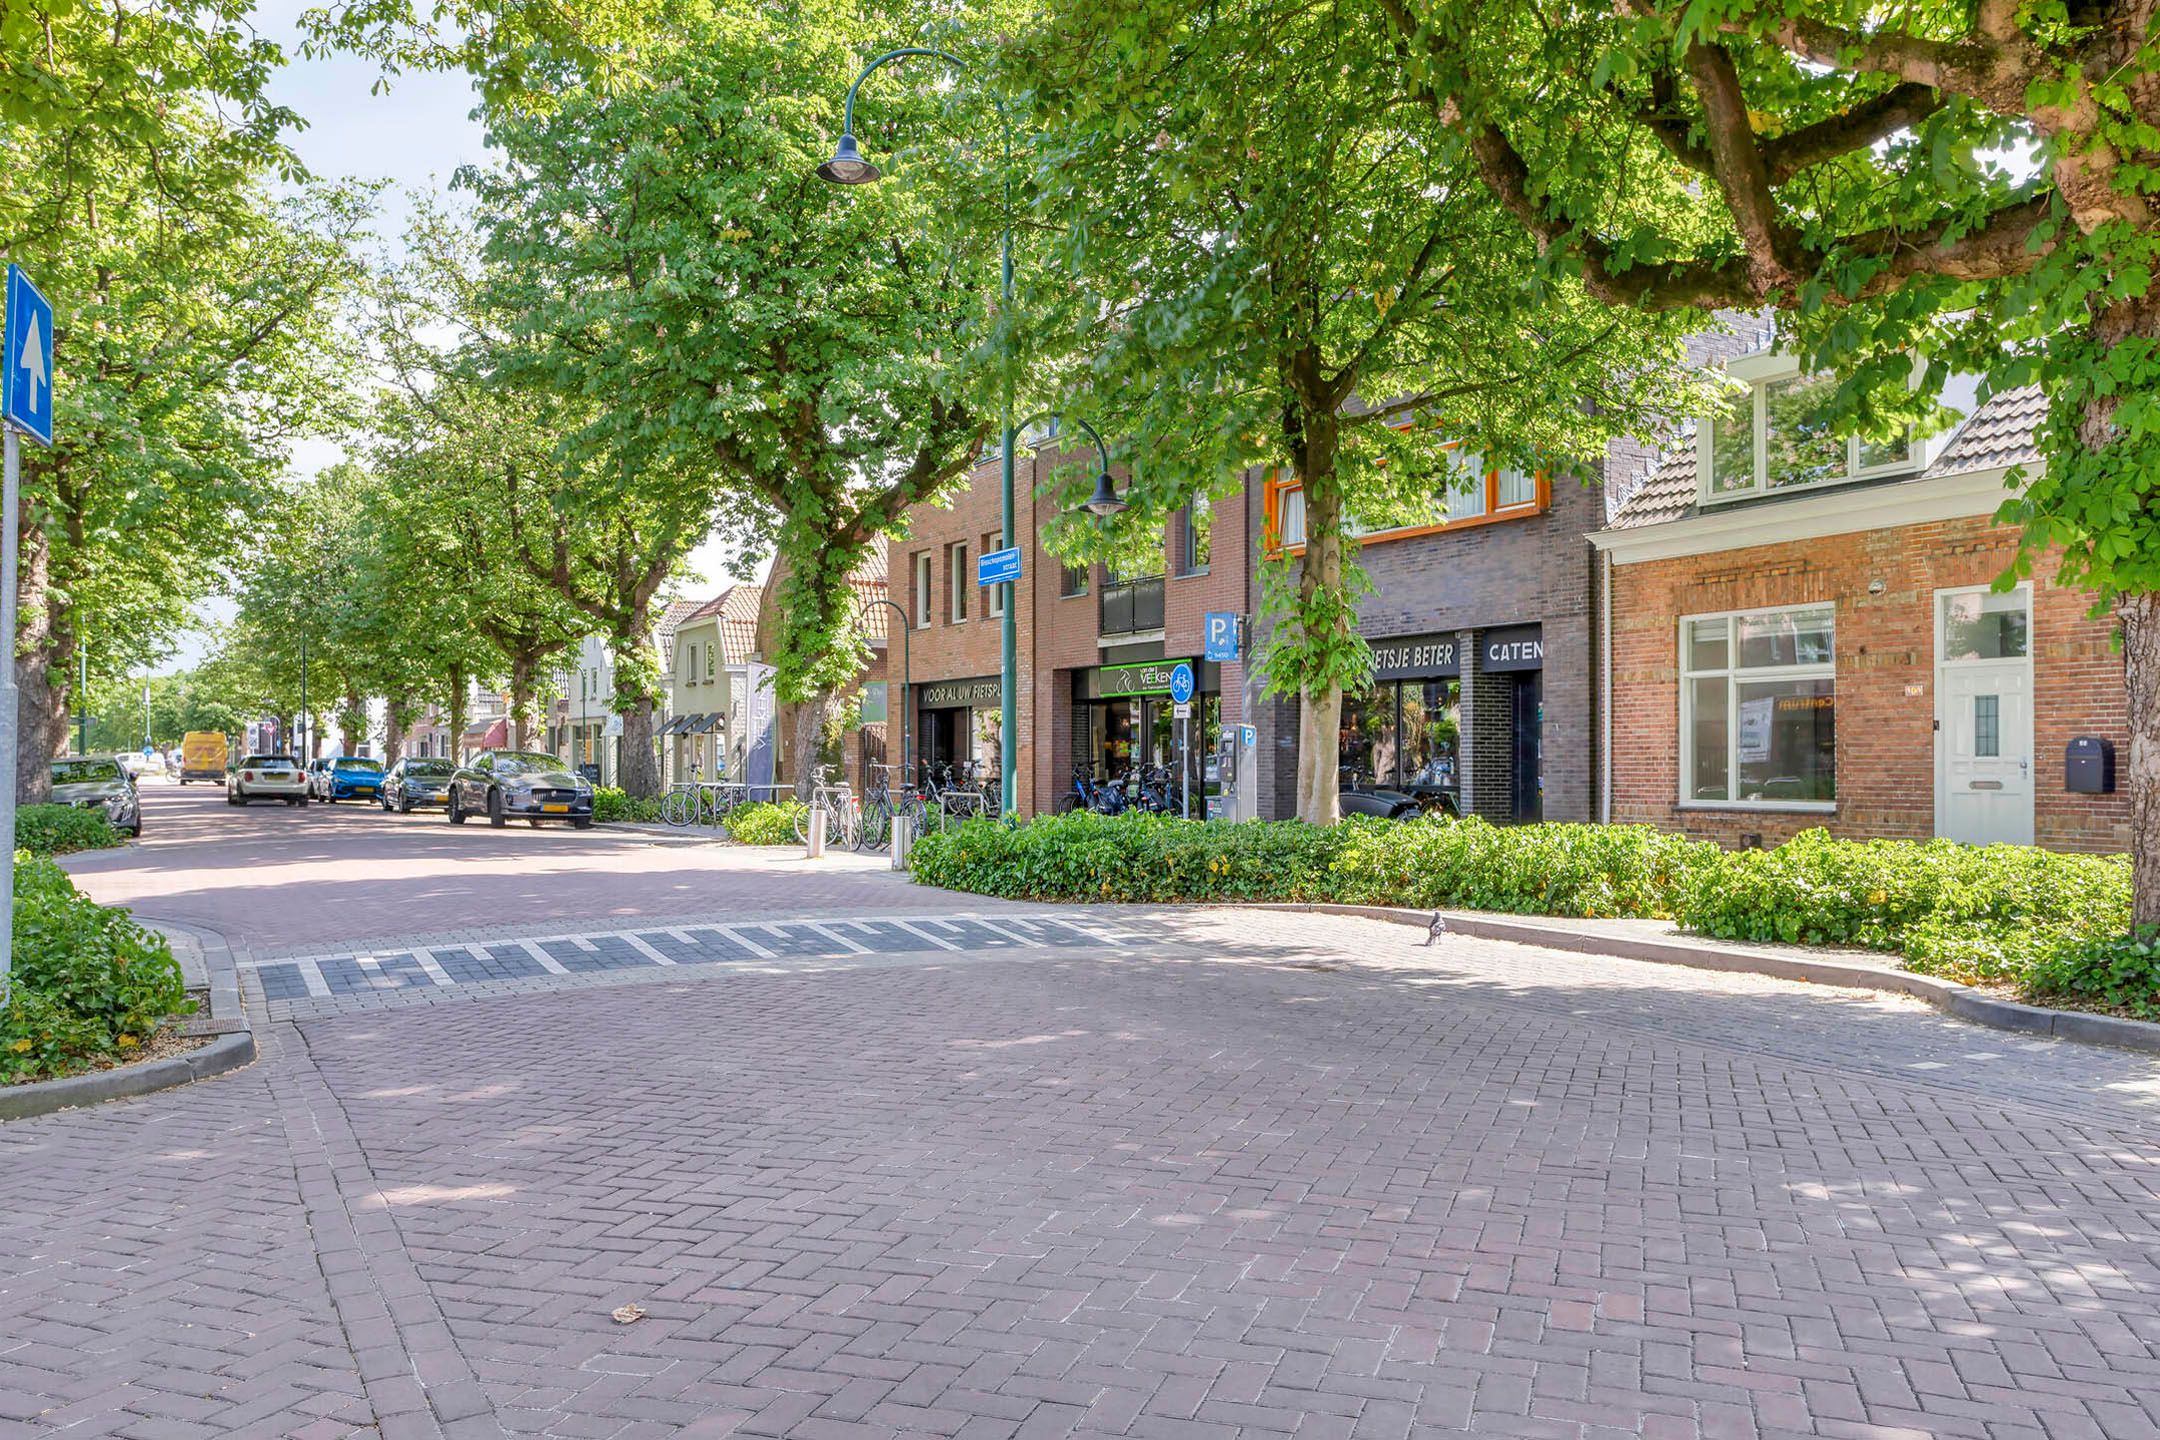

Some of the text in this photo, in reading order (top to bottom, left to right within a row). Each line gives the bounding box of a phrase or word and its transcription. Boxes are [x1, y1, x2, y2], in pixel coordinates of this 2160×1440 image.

[1211, 618, 1226, 643] P
[1414, 644, 1454, 666] BETER
[923, 688, 946, 702] VOOR
[946, 687, 956, 700] AL
[959, 685, 973, 699] UW
[1245, 729, 1253, 745] P
